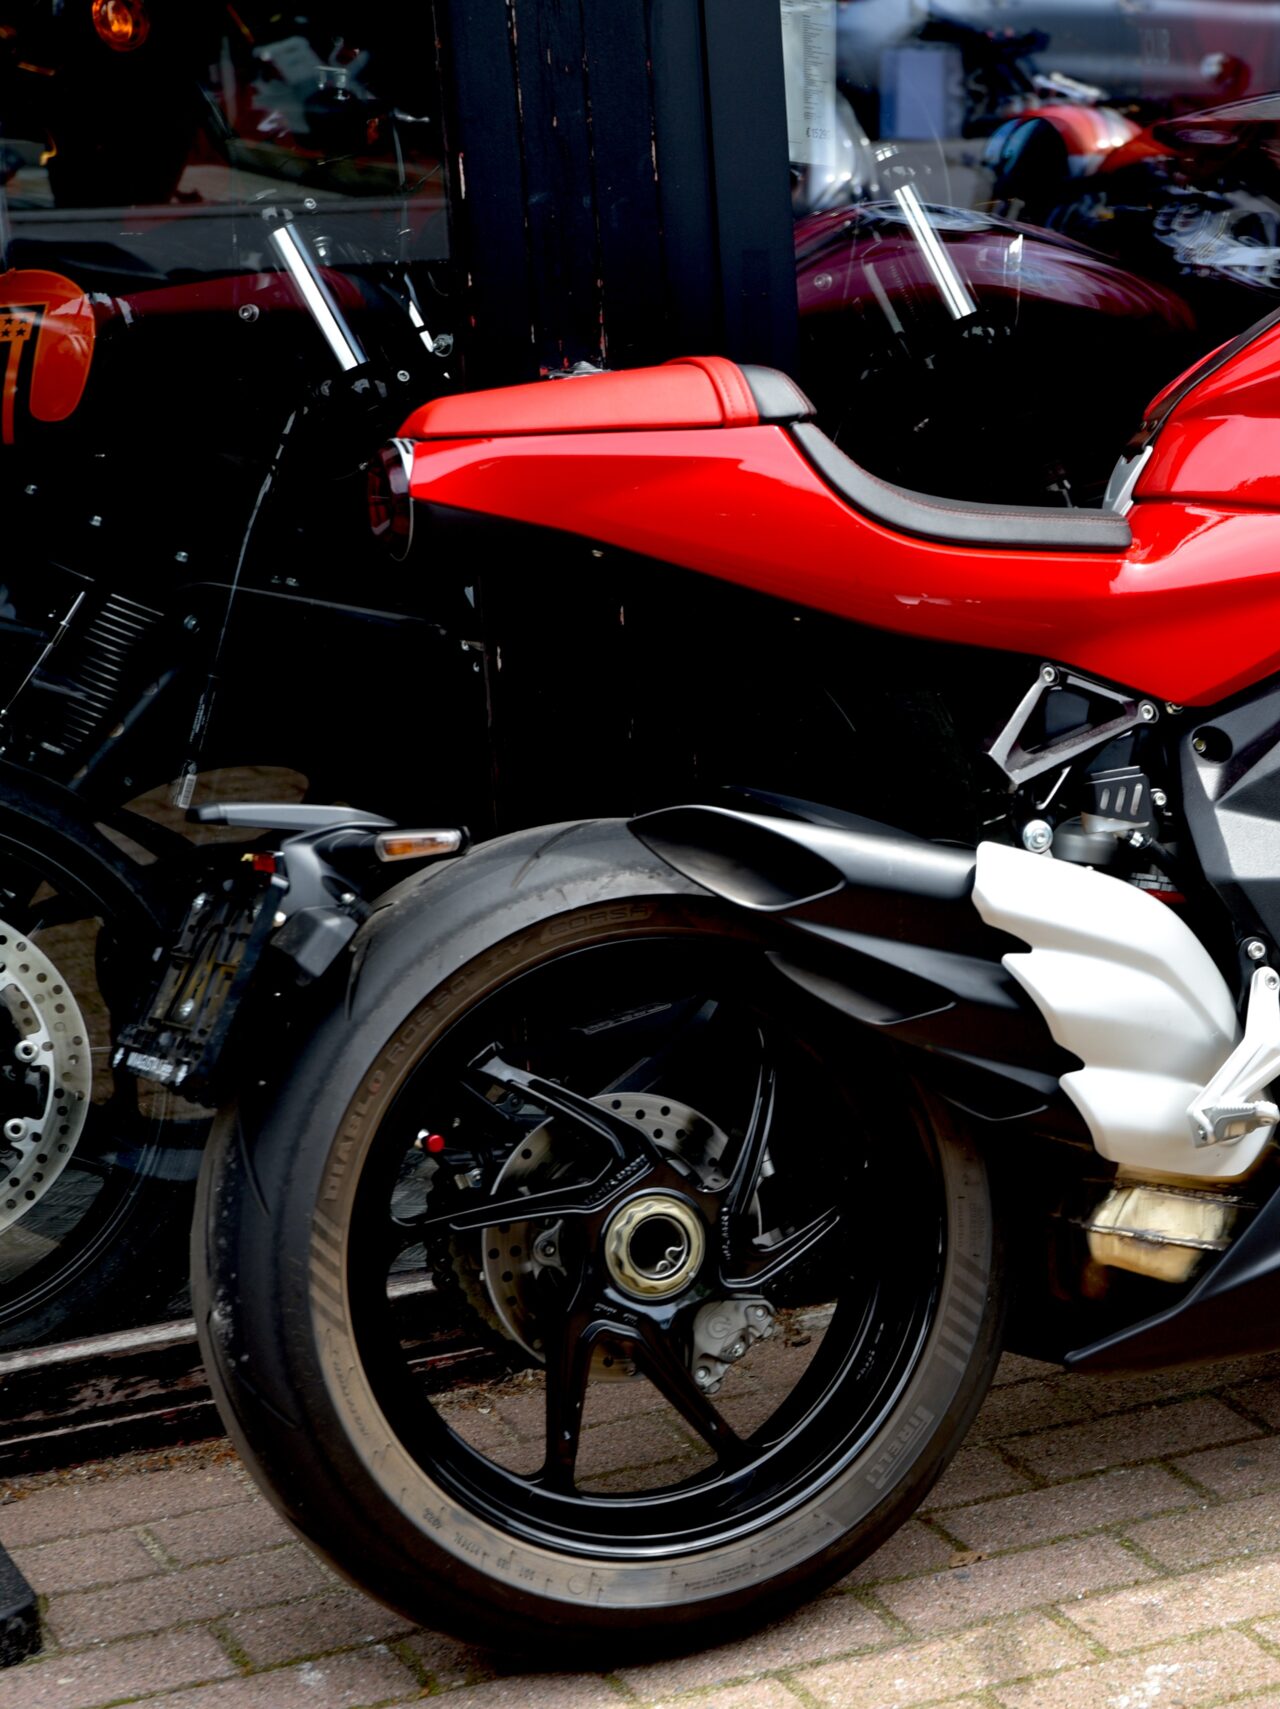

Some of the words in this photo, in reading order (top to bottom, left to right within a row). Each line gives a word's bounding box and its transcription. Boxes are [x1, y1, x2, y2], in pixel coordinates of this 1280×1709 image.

[318, 1067, 386, 1204] DIABLO
[384, 973, 470, 1067] ROSSO
[549, 905, 652, 936] CORSA
[866, 1405, 936, 1490] PIRELLI
